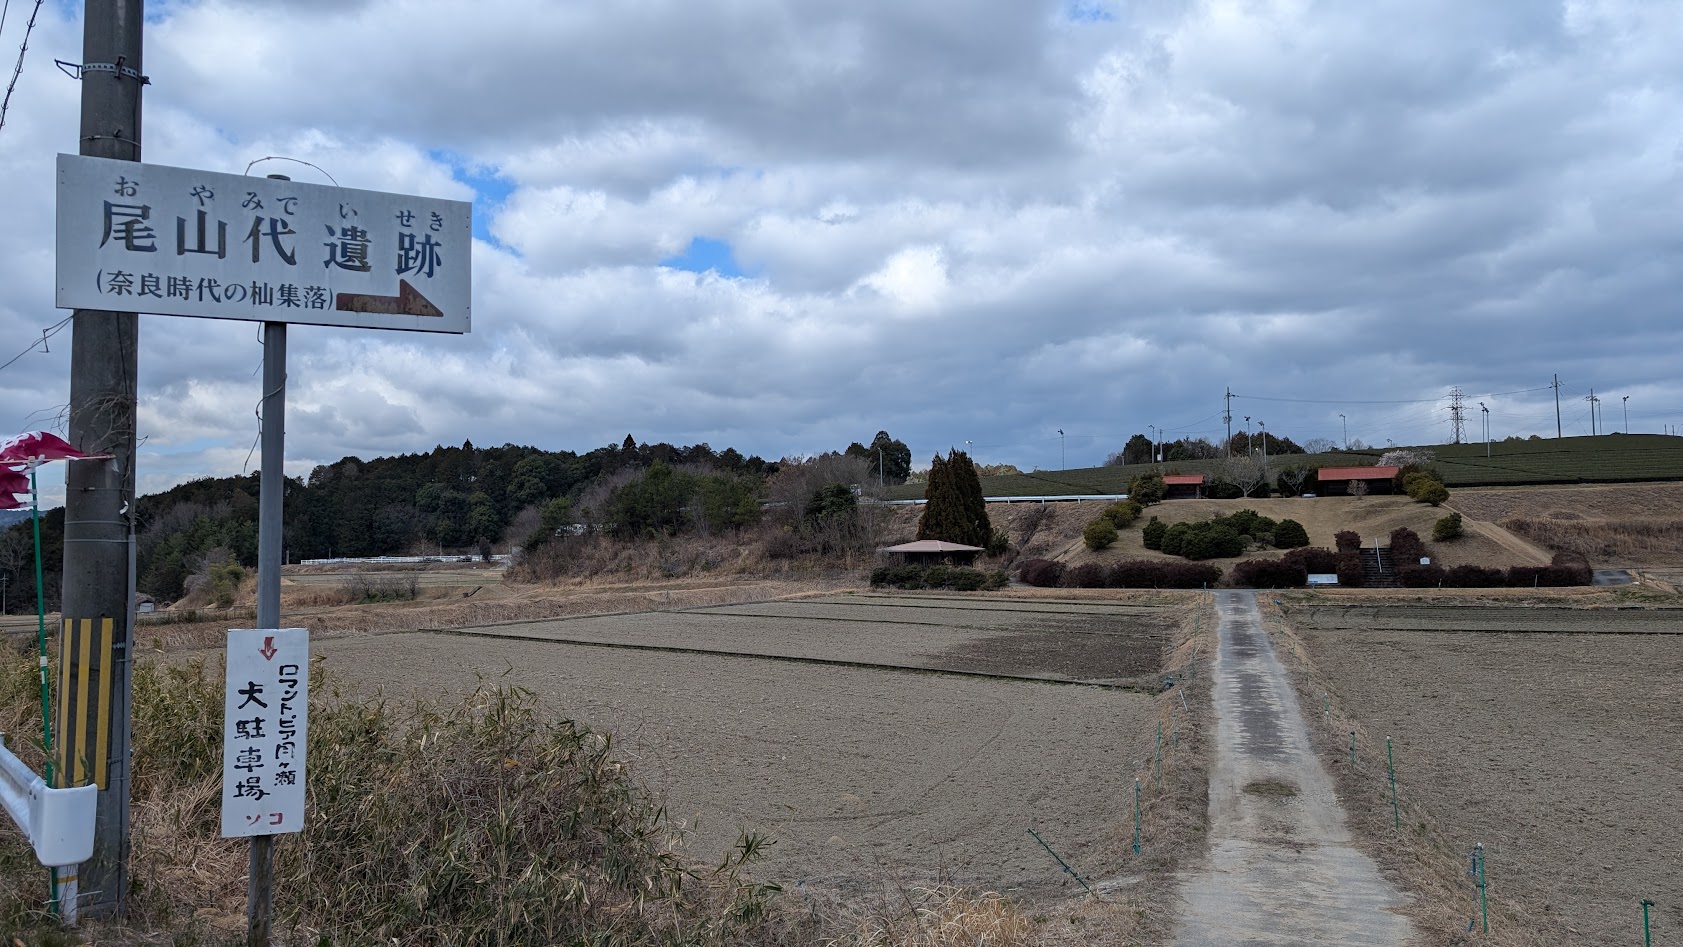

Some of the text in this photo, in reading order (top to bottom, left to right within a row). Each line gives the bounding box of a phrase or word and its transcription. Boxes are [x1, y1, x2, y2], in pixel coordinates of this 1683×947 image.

[114, 175, 443, 233] おやみでいせき
[99, 198, 442, 280] 尾山代遺跡
[96, 268, 335, 312] (奈良時代の杣集落)
